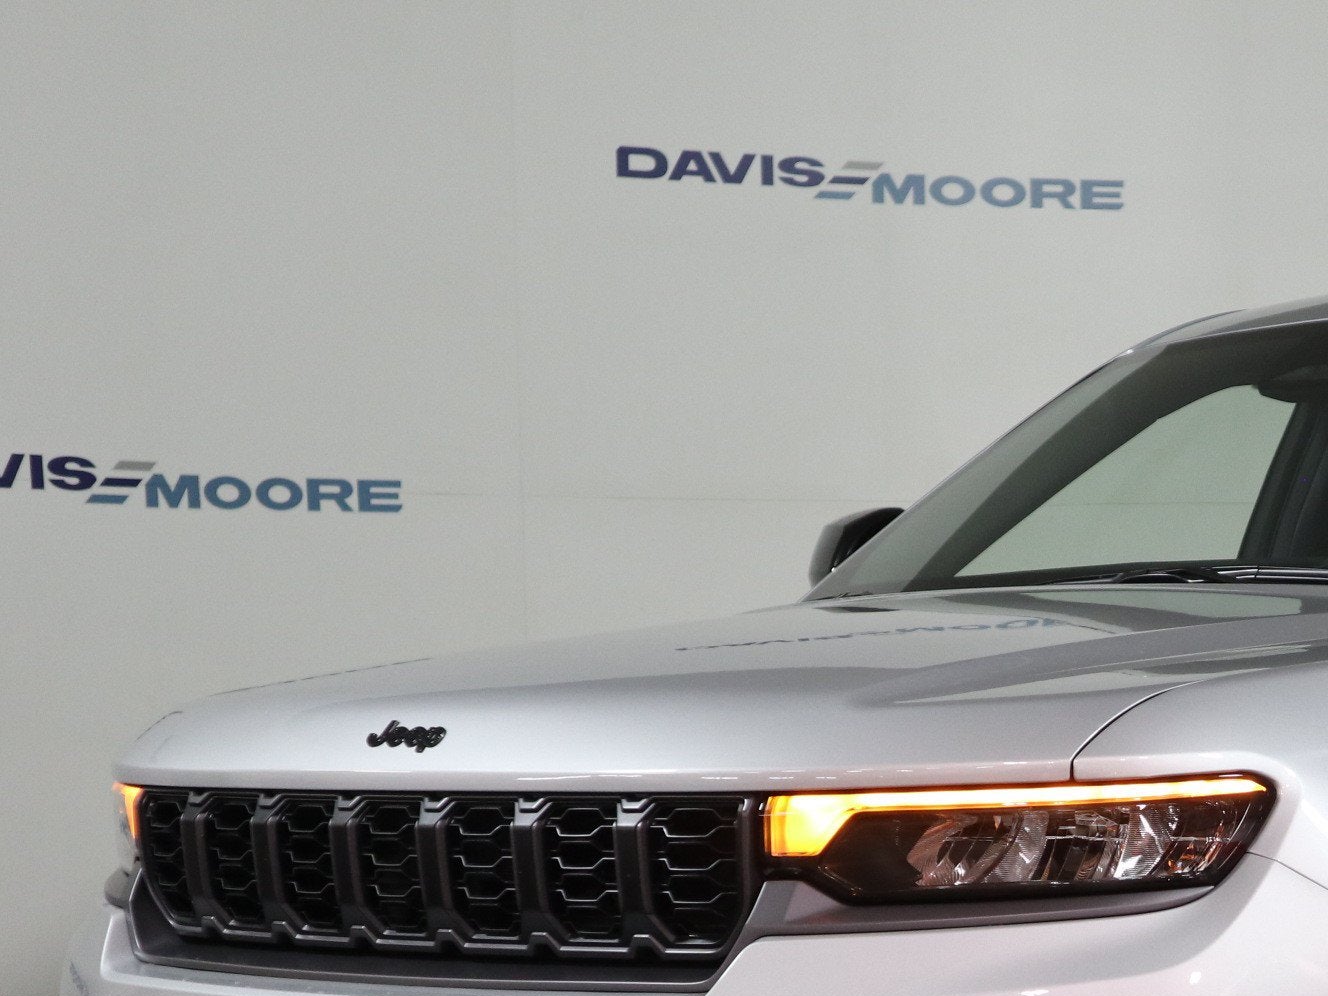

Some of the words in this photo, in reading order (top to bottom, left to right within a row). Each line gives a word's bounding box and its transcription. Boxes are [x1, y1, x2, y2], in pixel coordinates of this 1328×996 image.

[615, 145, 826, 187] DAVIS
[871, 172, 1124, 211] MOORE
[144, 473, 403, 513] MOORE
[366, 720, 447, 753] Jeep
